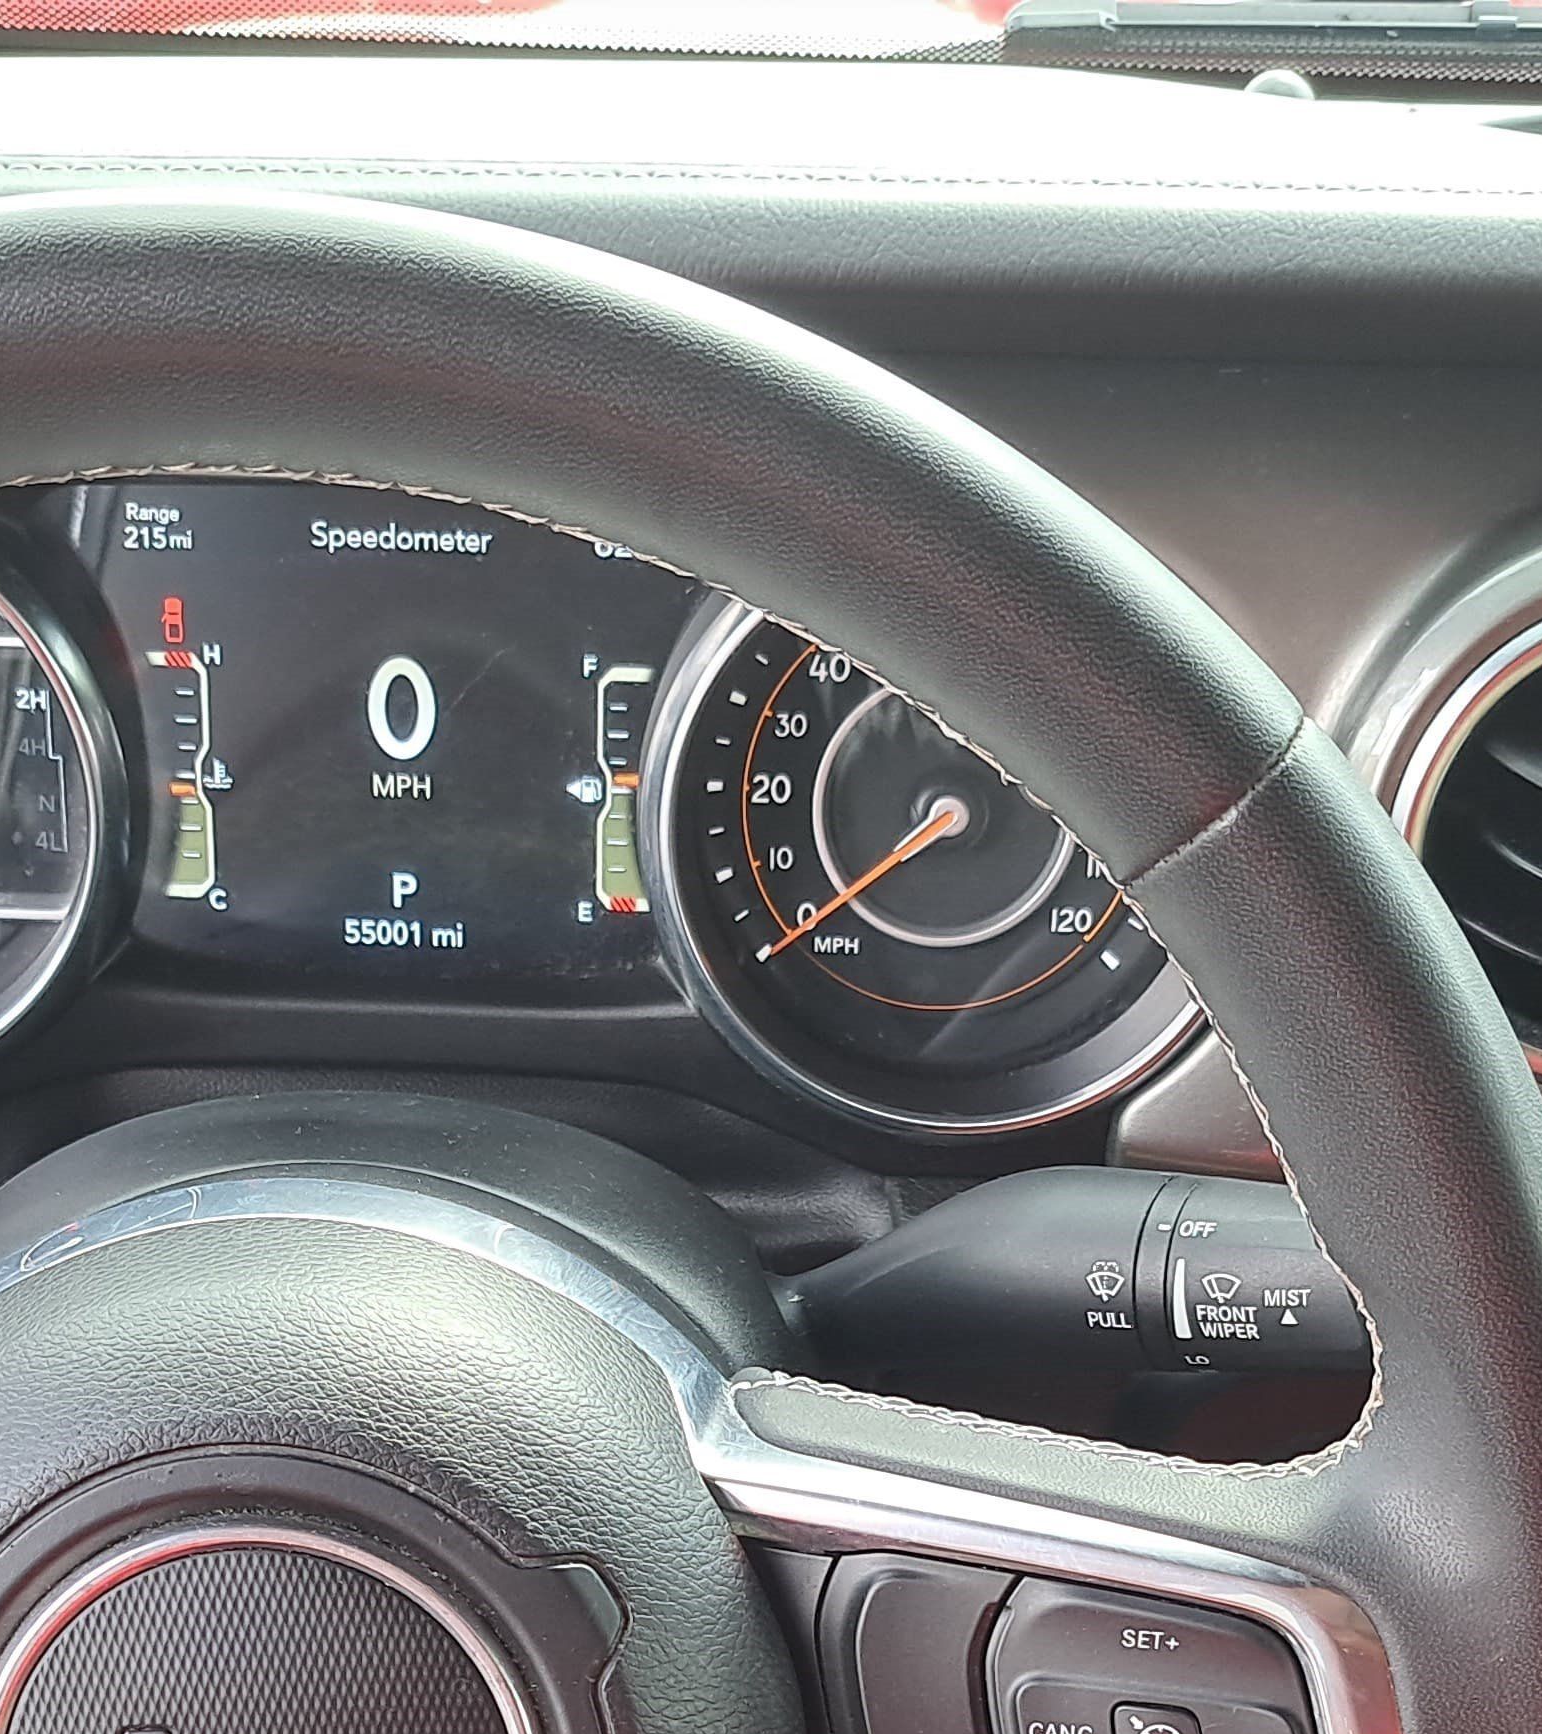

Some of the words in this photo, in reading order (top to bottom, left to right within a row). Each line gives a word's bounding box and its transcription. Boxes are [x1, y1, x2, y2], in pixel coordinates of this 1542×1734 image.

[125, 502, 180, 525] Range
[310, 520, 493, 554] Speedometer
[202, 643, 221, 667] H
[583, 653, 598, 678] F
[808, 654, 852, 683] 40
[15, 688, 47, 711] 2H
[367, 656, 436, 760] 0
[774, 713, 808, 738] 30
[18, 737, 47, 757] 4H
[372, 772, 431, 800] MPH
[751, 774, 791, 804] 20
[38, 794, 56, 813] N
[769, 846, 794, 871] 10
[208, 887, 228, 910] C
[392, 871, 418, 908] P
[577, 900, 593, 923] E
[1050, 910, 1092, 935] 120
[344, 918, 421, 948] 55001
[431, 922, 463, 948] mi
[814, 936, 860, 955] MPH
[1179, 1220, 1218, 1238] OFF
[1263, 1288, 1312, 1307] MIST
[1086, 1311, 1132, 1329] PULL
[1196, 1304, 1258, 1323] FRONT
[1199, 1321, 1260, 1340] WIPER
[1121, 1629, 1180, 1650] SET+
